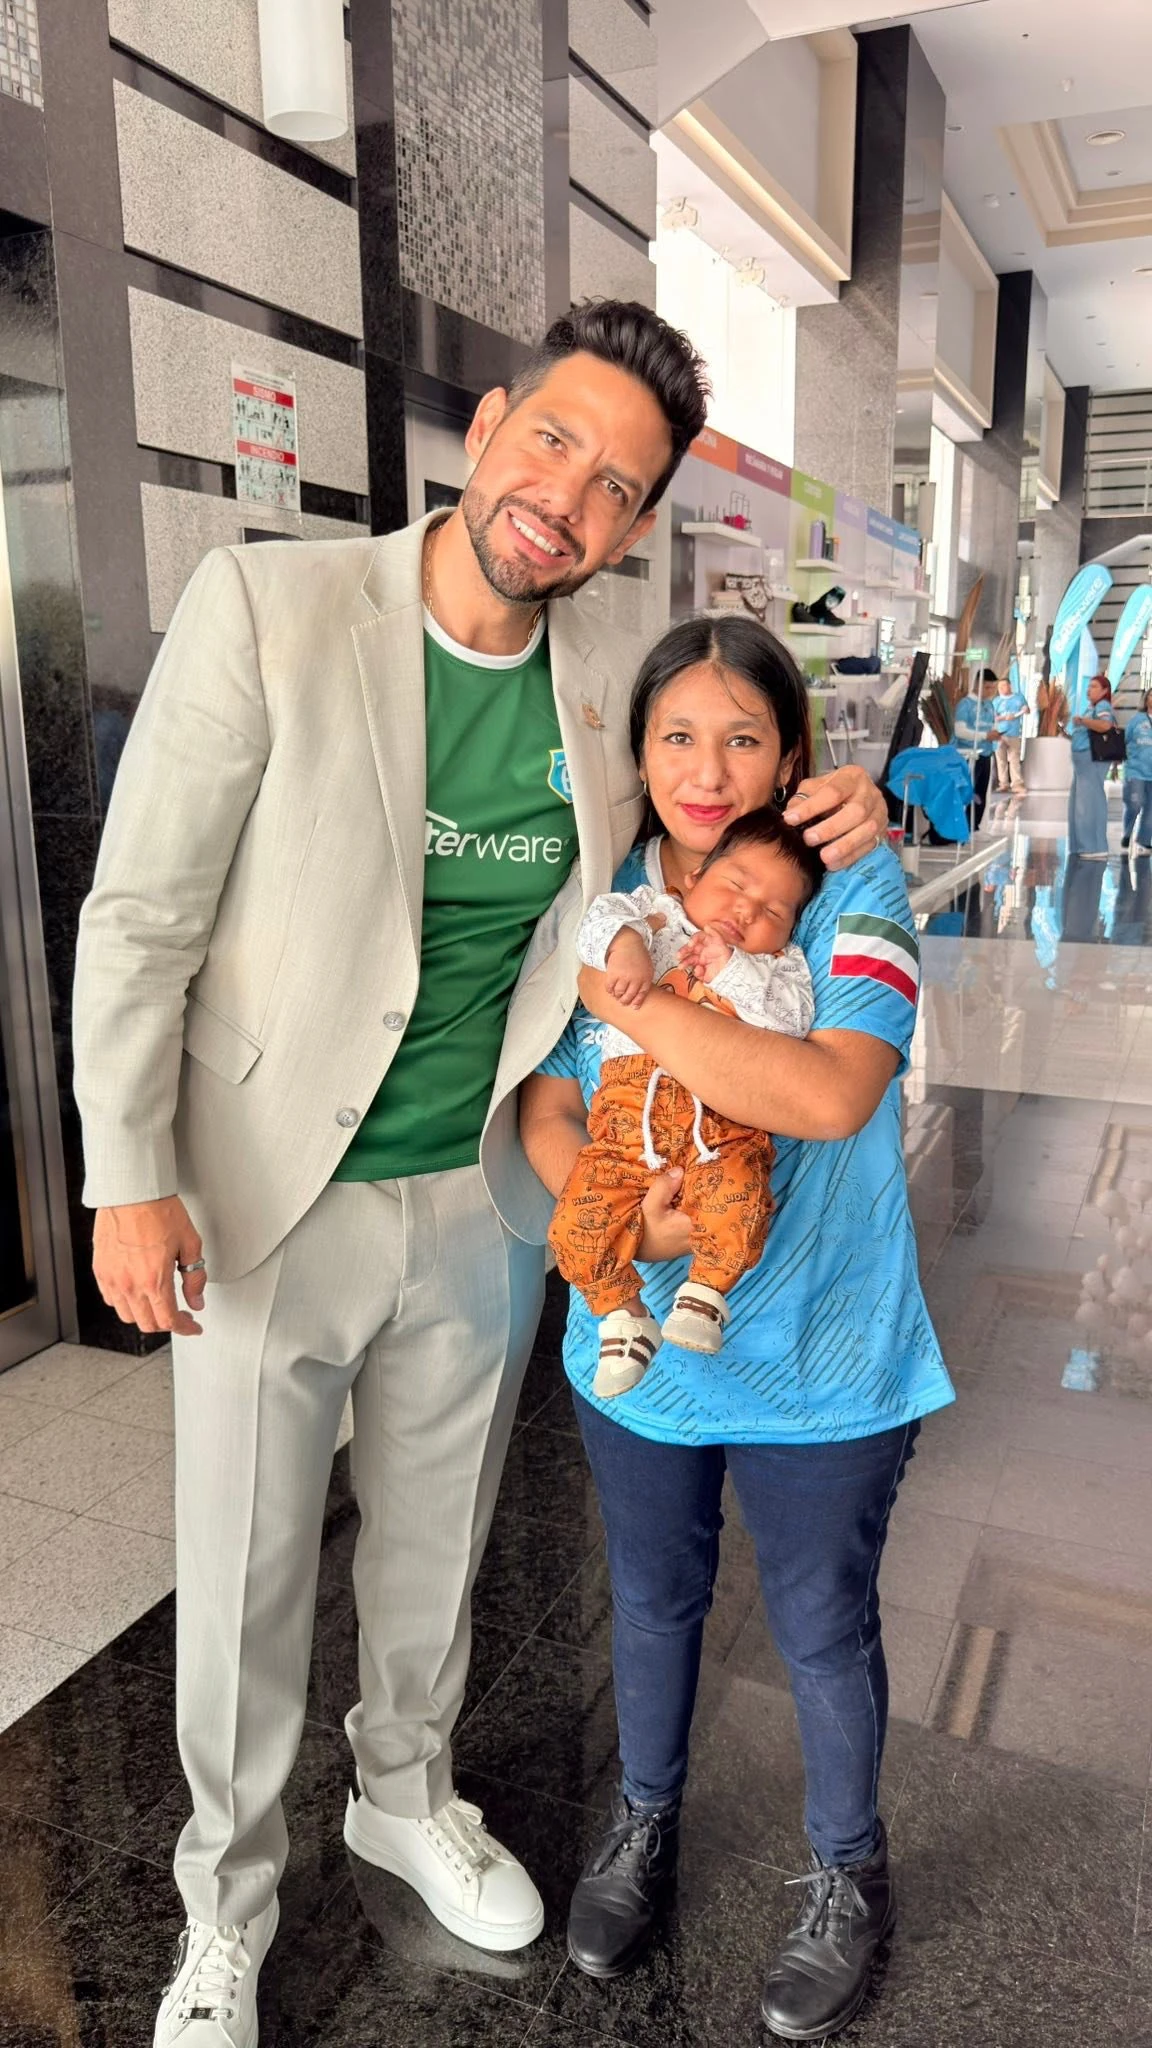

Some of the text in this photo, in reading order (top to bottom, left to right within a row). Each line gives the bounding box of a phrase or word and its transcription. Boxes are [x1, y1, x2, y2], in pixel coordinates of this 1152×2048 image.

[425, 821, 562, 863] terware
[572, 1193, 603, 1206] HELLO
[724, 1192, 749, 1203] LION
